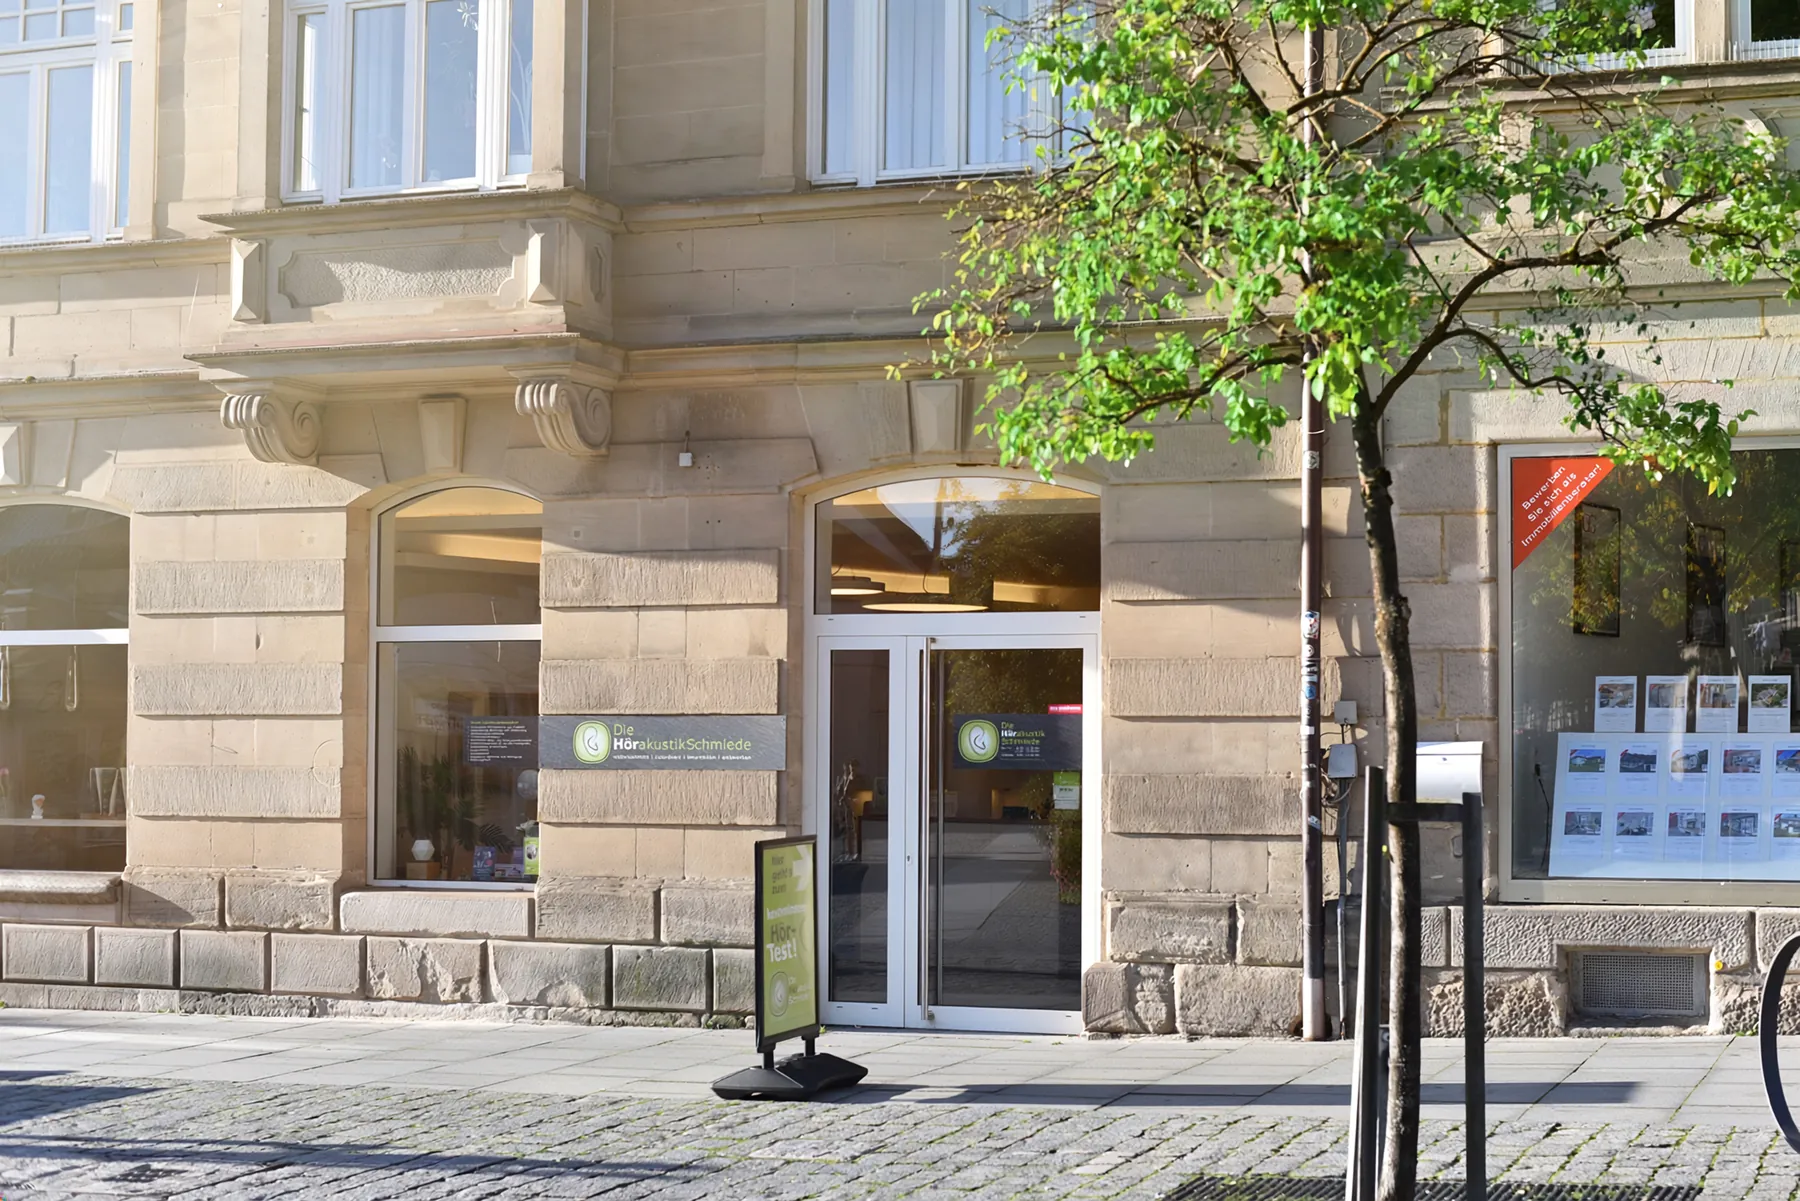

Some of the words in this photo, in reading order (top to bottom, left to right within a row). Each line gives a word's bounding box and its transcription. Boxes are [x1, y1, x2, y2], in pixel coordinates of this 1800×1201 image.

[1527, 507, 1544, 522] Sie
[1543, 487, 1562, 507] sich
[1562, 472, 1577, 488] als
[613, 723, 634, 736] Die
[613, 738, 752, 751] HörakustikSchmiede
[770, 922, 796, 944] Hör-
[766, 938, 798, 963] Test!
